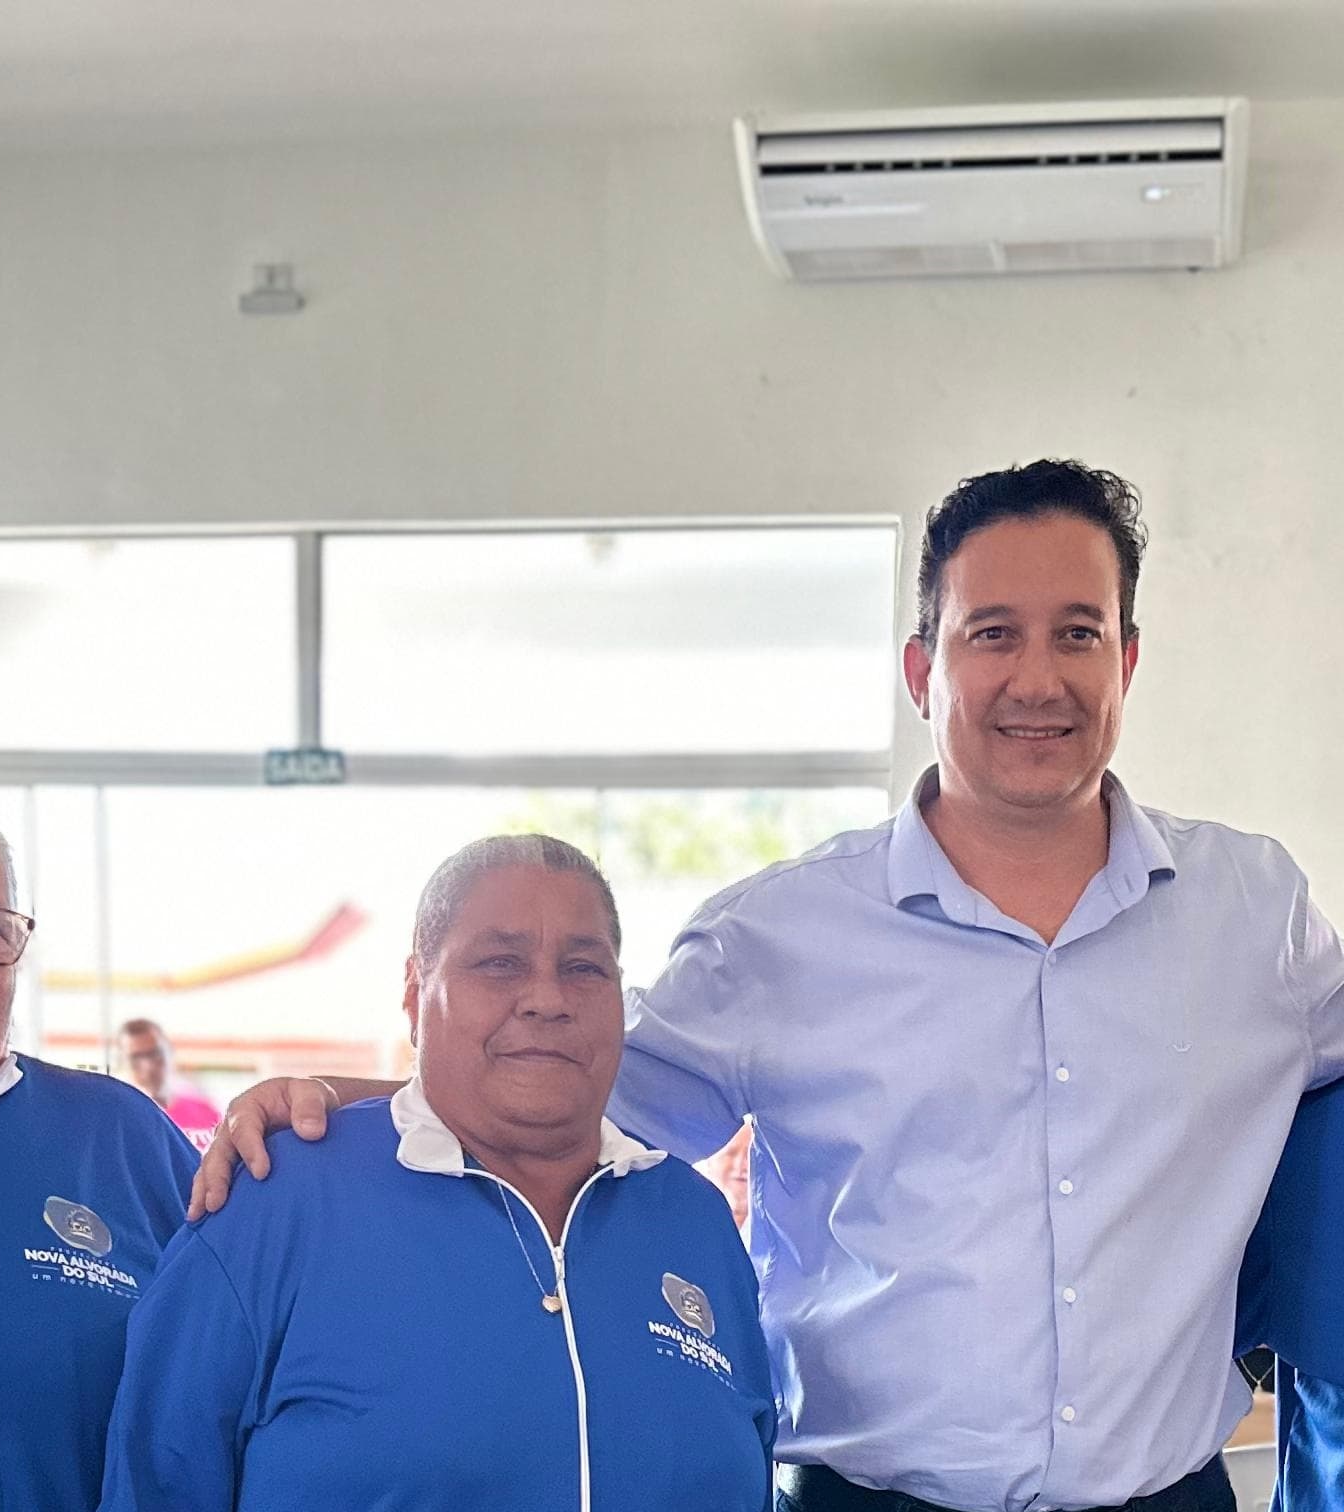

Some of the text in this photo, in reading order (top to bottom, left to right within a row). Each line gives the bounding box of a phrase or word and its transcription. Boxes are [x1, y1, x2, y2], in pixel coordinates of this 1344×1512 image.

[24, 1248, 69, 1265] NOVA
[70, 1256, 138, 1289] ALVORADA
[32, 1273, 52, 1281] um
[62, 1265, 115, 1289] DO SUL
[647, 1321, 686, 1343] NOVA
[680, 1342, 699, 1359] DO
